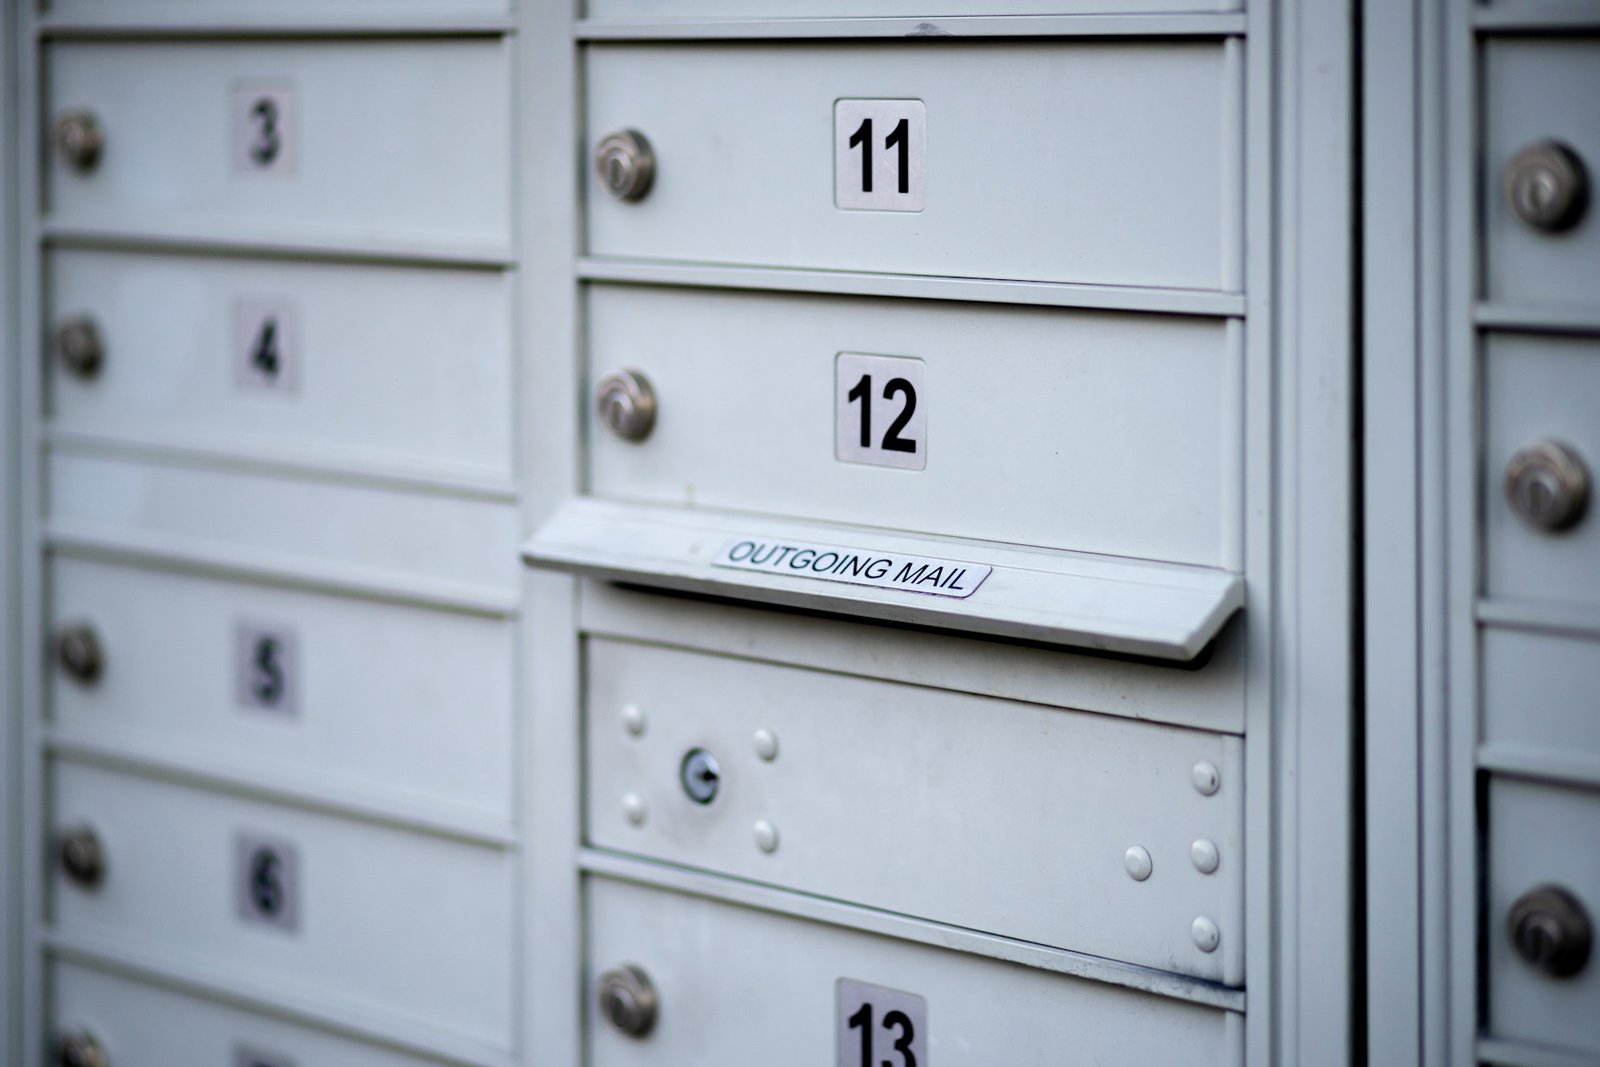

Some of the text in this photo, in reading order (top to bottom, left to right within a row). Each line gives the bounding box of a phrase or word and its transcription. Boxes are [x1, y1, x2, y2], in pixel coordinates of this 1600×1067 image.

[249, 98, 281, 167] 3
[849, 118, 909, 194] 11
[249, 319, 281, 380] 4
[848, 374, 917, 454] 12
[728, 541, 967, 590] OUTGOING MAIL
[248, 635, 285, 707] 5
[247, 845, 285, 921] 6
[847, 1002, 918, 1067] 13
